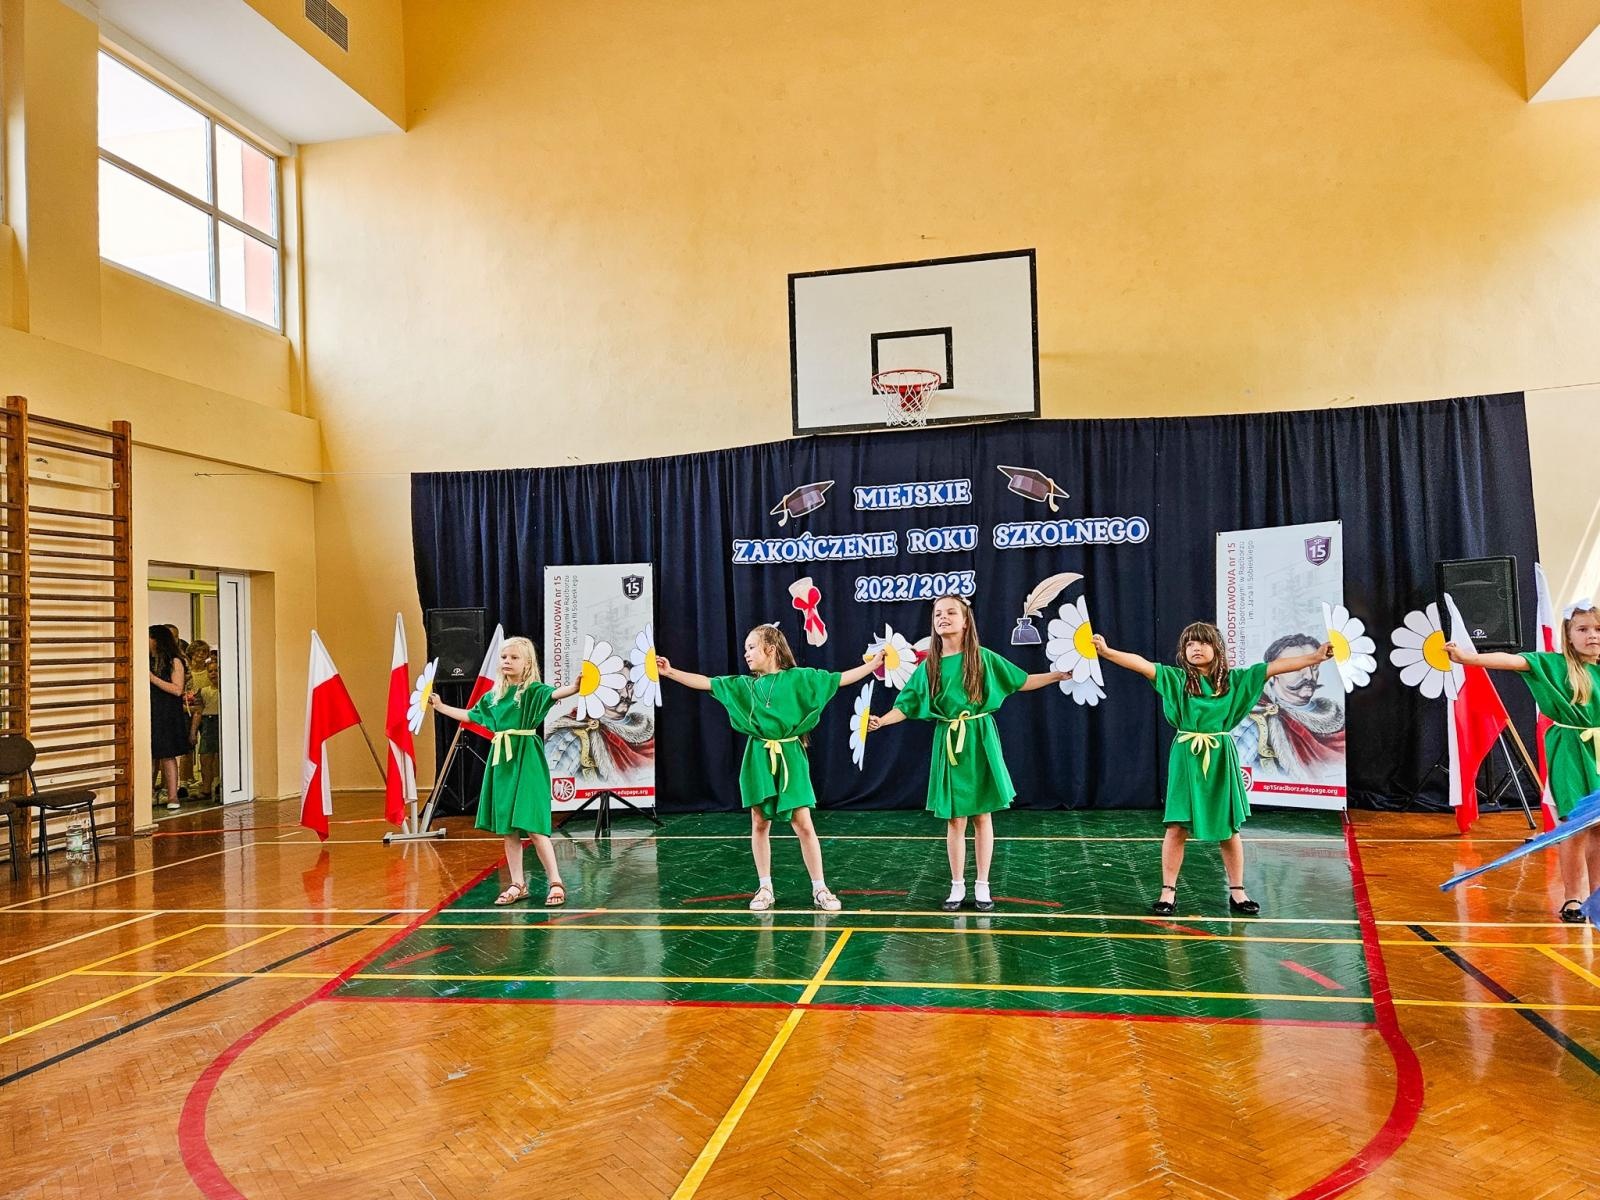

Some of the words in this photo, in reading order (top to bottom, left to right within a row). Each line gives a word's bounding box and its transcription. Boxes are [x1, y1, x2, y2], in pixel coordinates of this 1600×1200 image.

[856, 480, 970, 509] MIEJSKIE
[734, 531, 895, 562] ZAKOŃCZENIE
[910, 527, 977, 552] ROKU
[995, 518, 1147, 546] SZKOLNEGO
[1227, 542, 1236, 554] 15
[1308, 544, 1326, 558] 15
[1229, 557, 1236, 567] nr
[554, 575, 562, 586] 15
[625, 582, 640, 594] 15
[857, 572, 975, 600] 2022/2023
[555, 588, 562, 598] nr
[1227, 568, 1236, 644] PODSTAWOWA
[554, 599, 562, 667] PODSTAWOWA
[554, 669, 562, 706] SOŁA
